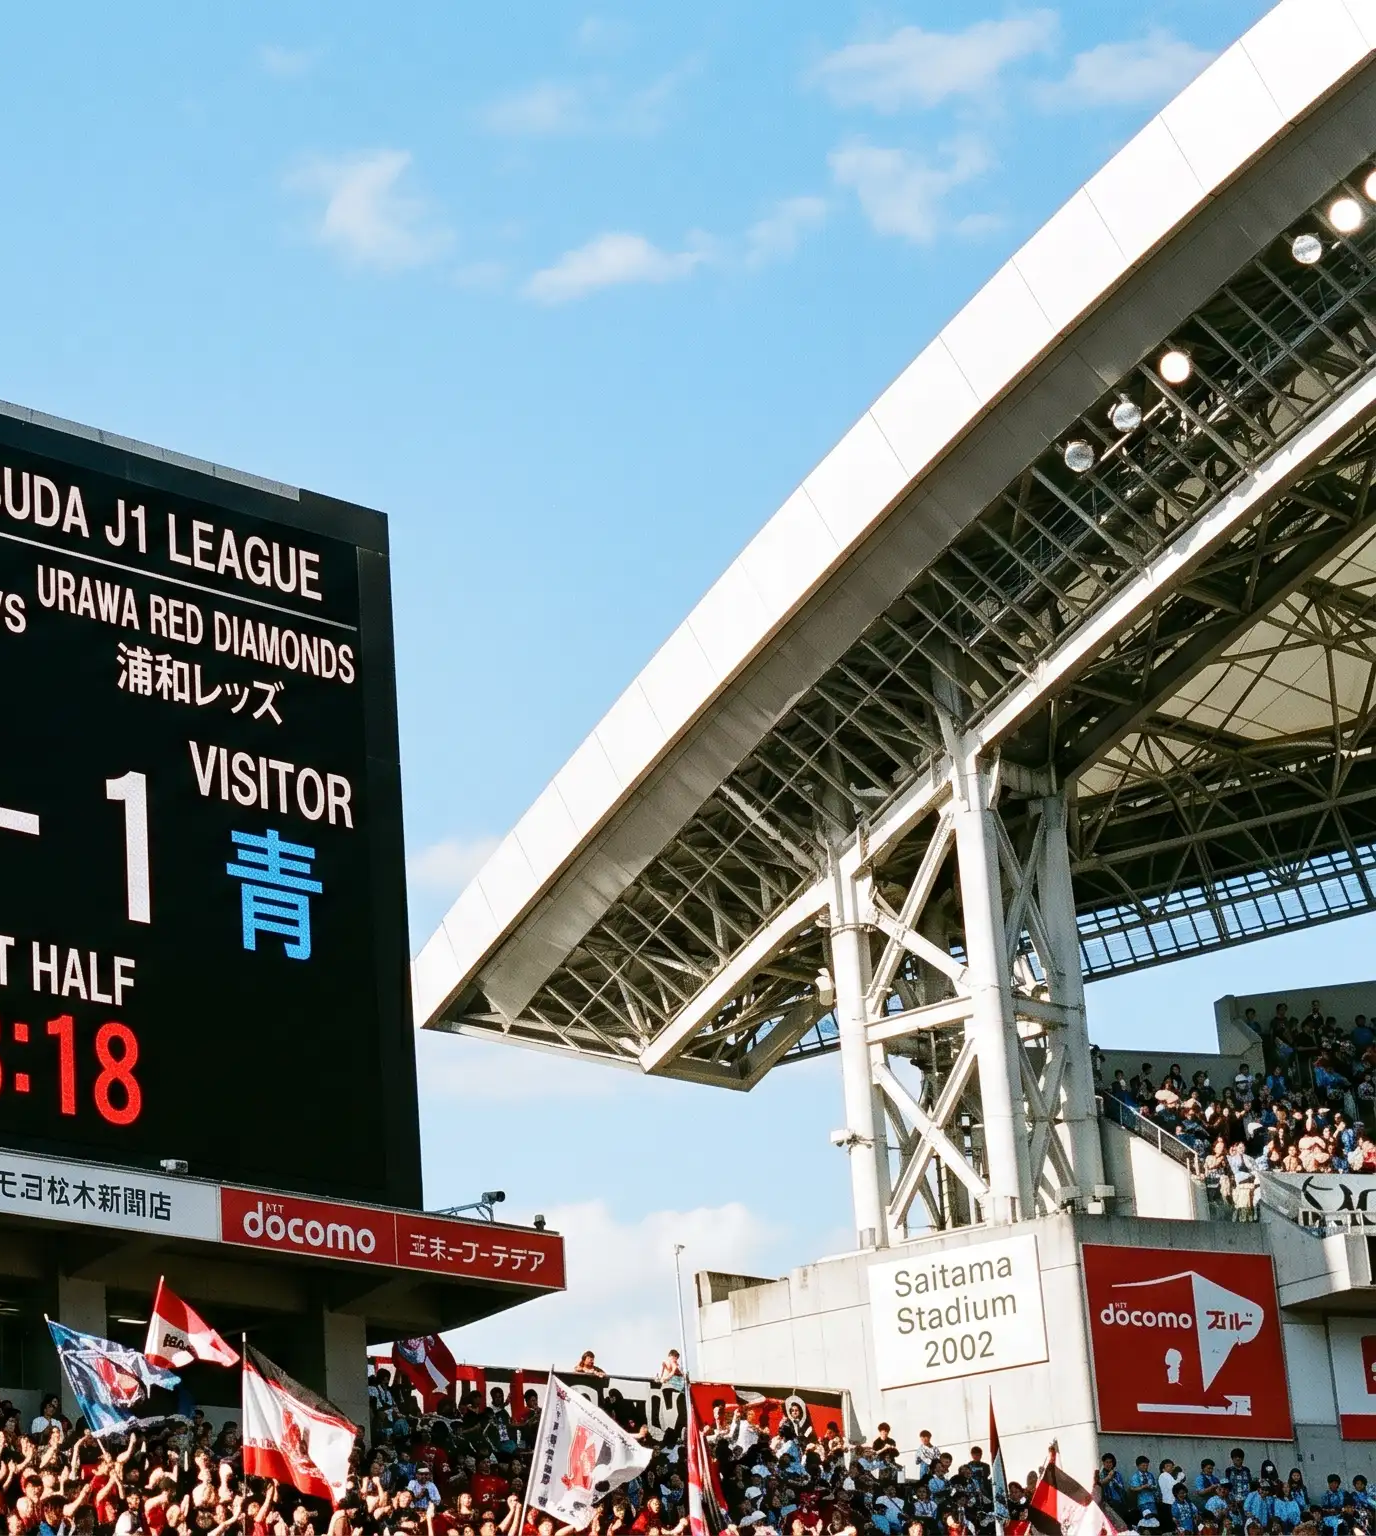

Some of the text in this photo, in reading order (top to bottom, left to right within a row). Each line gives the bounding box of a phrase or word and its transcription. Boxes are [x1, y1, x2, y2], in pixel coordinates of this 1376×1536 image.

[105, 500, 148, 553] J1
[168, 513, 321, 601] LEAGUE
[38, 564, 355, 683] URAWA RED DIAMONDS
[118, 642, 285, 724] 浦和レッズ
[189, 741, 353, 828] VISITOR
[106, 771, 150, 923] 1
[227, 829, 322, 960] 青
[33, 942, 135, 1005] HALF
[243, 1201, 376, 1255] docomo
[894, 1257, 1012, 1298] Saitama
[897, 1294, 1017, 1335] Stadium
[924, 1330, 995, 1369] 2002
[1100, 1303, 1193, 1329] docomo
